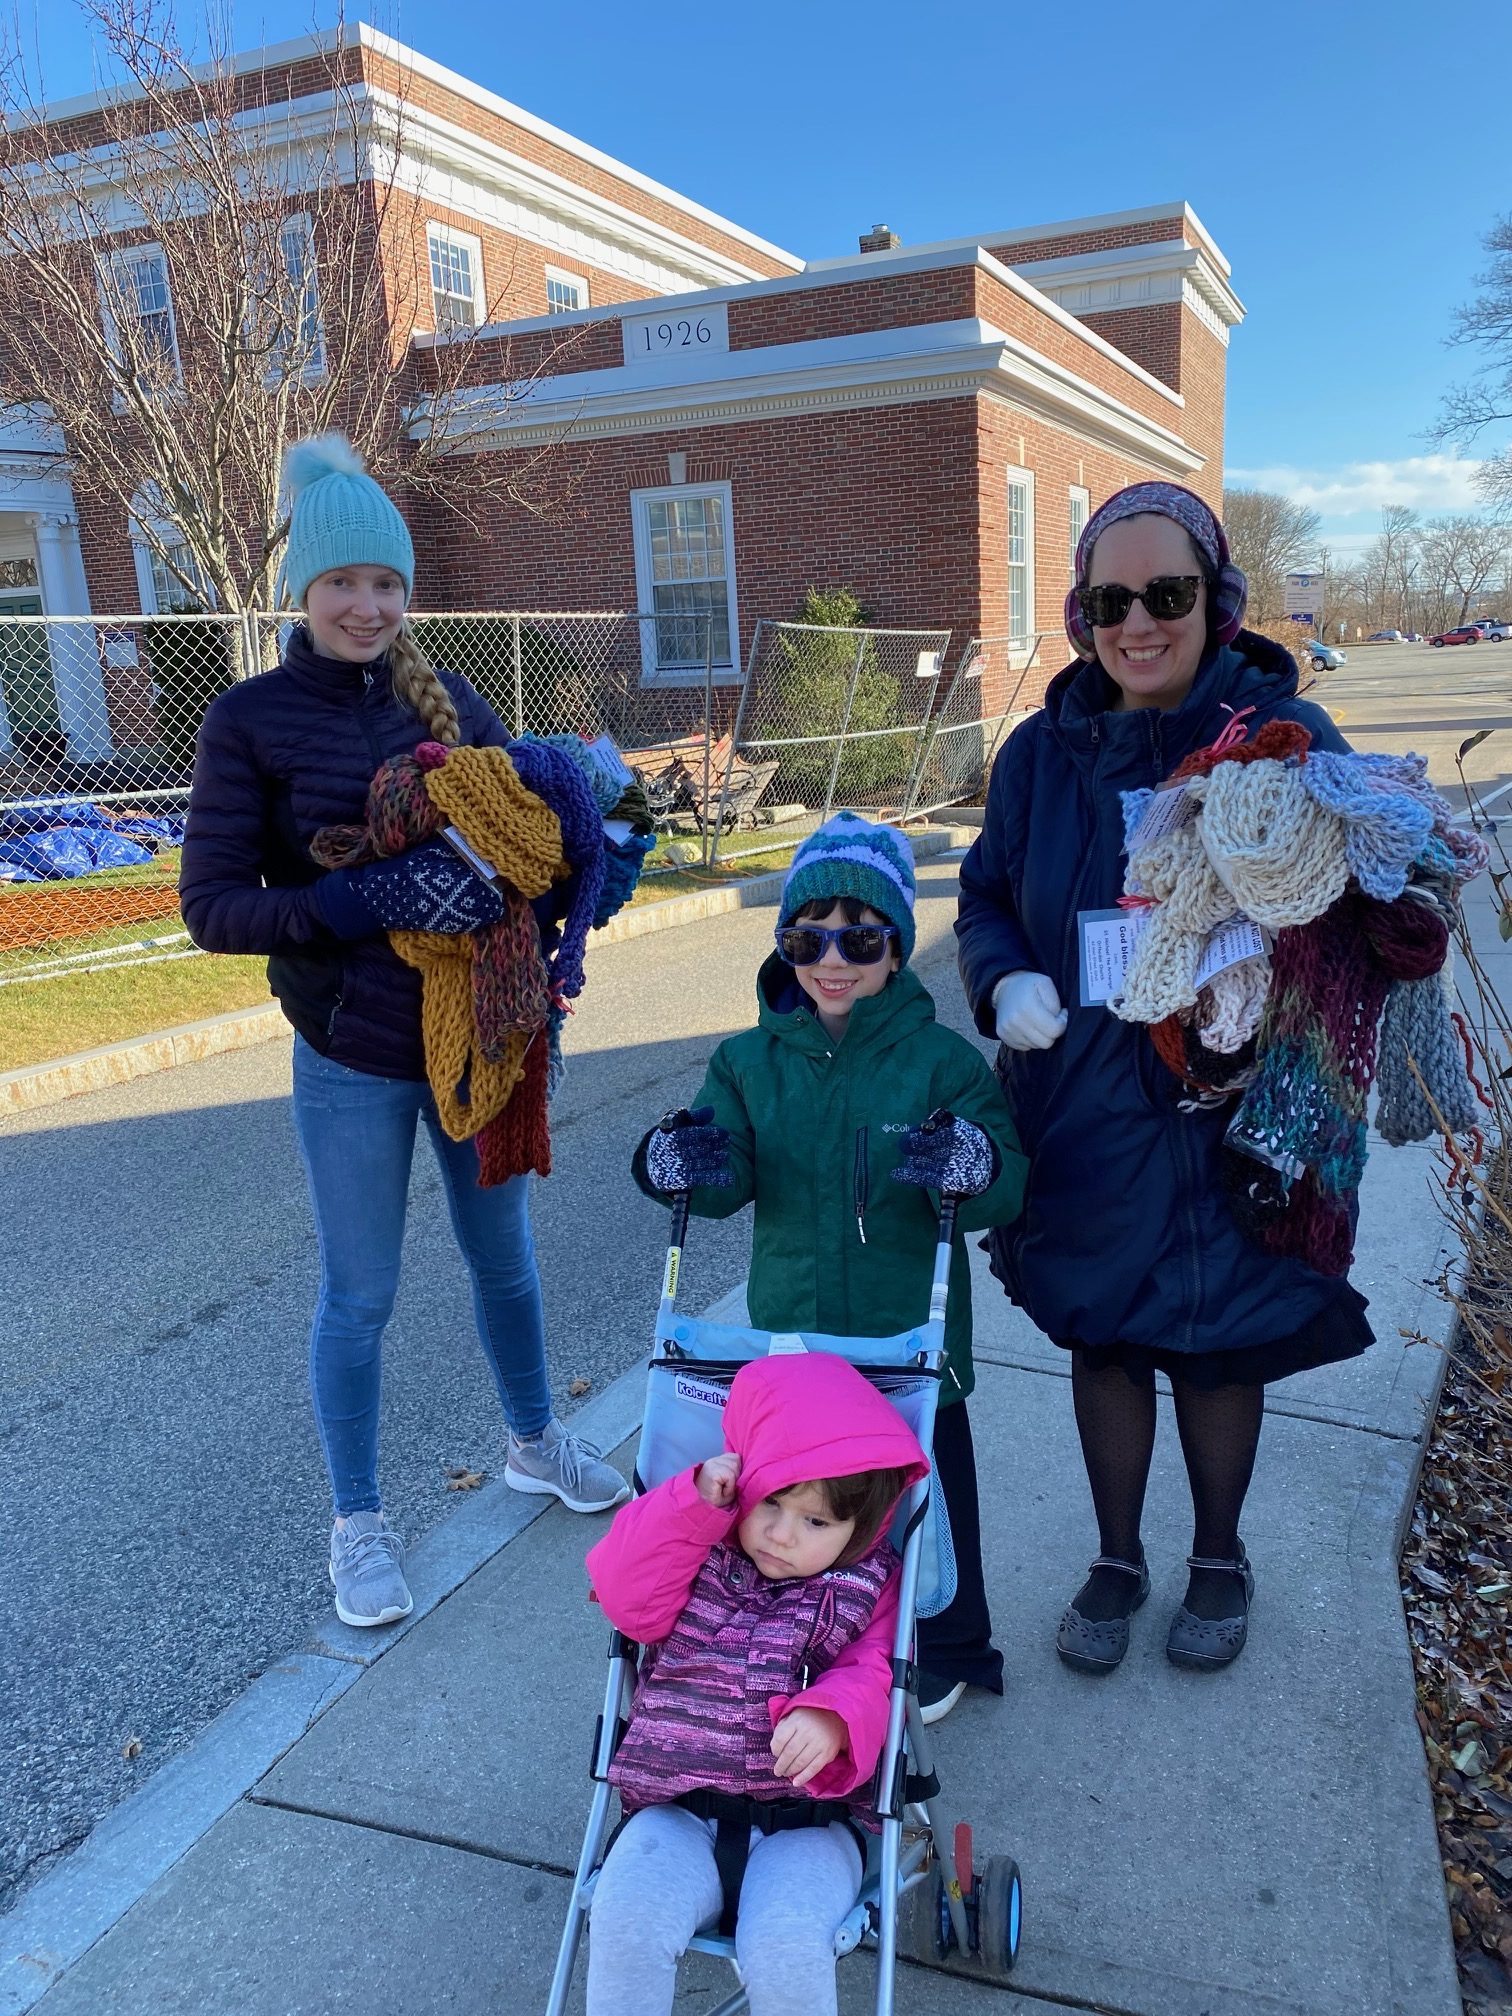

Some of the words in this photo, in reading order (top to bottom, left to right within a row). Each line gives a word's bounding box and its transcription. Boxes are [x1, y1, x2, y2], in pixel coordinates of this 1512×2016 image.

[644, 317, 711, 351] 1926
[668, 1259, 677, 1294] WARNING
[678, 1382, 723, 1406] Kolcraft
[833, 1571, 874, 1591] Columbia
